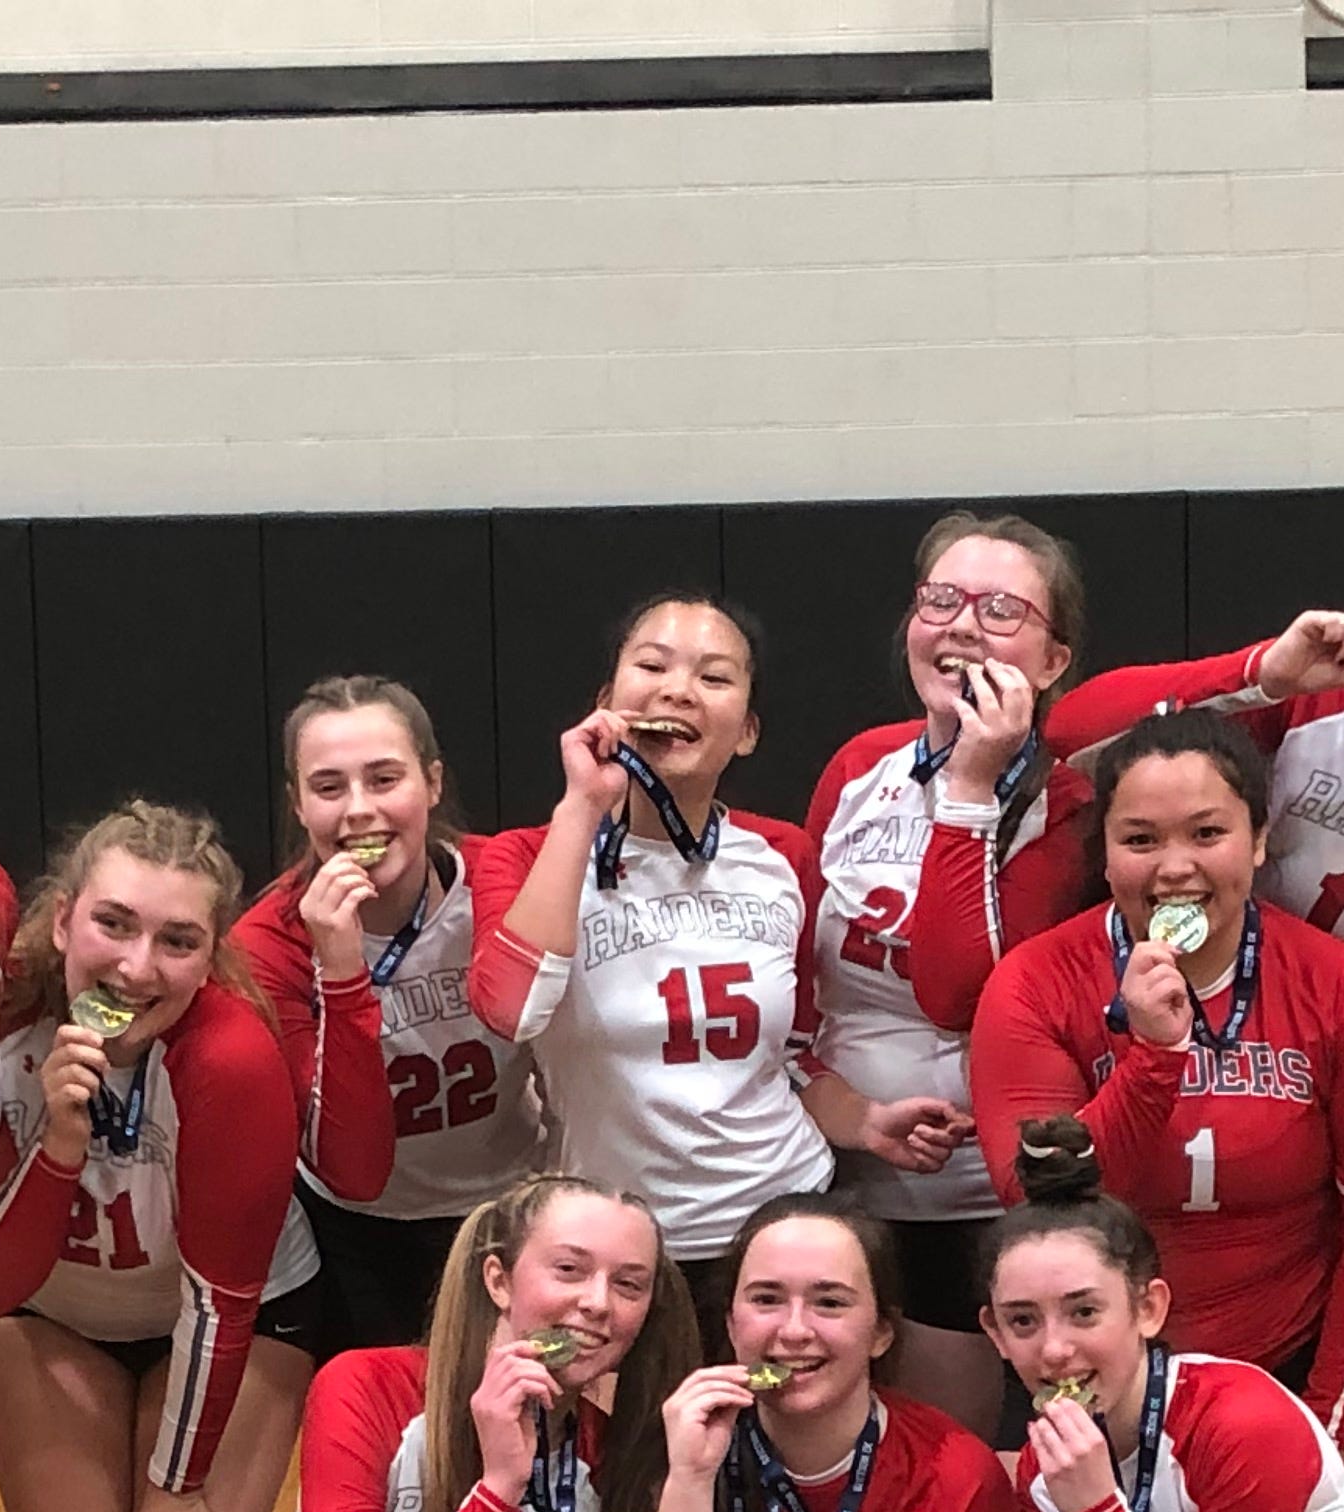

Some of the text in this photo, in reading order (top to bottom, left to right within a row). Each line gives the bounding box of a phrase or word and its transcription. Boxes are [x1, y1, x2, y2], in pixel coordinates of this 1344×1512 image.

[582, 891, 796, 971] RAIDERS
[840, 886, 912, 981] 2
[658, 961, 760, 1064] 15
[386, 1038, 498, 1138] 22
[1182, 1127, 1220, 1212] 1
[60, 1186, 151, 1270] 21
